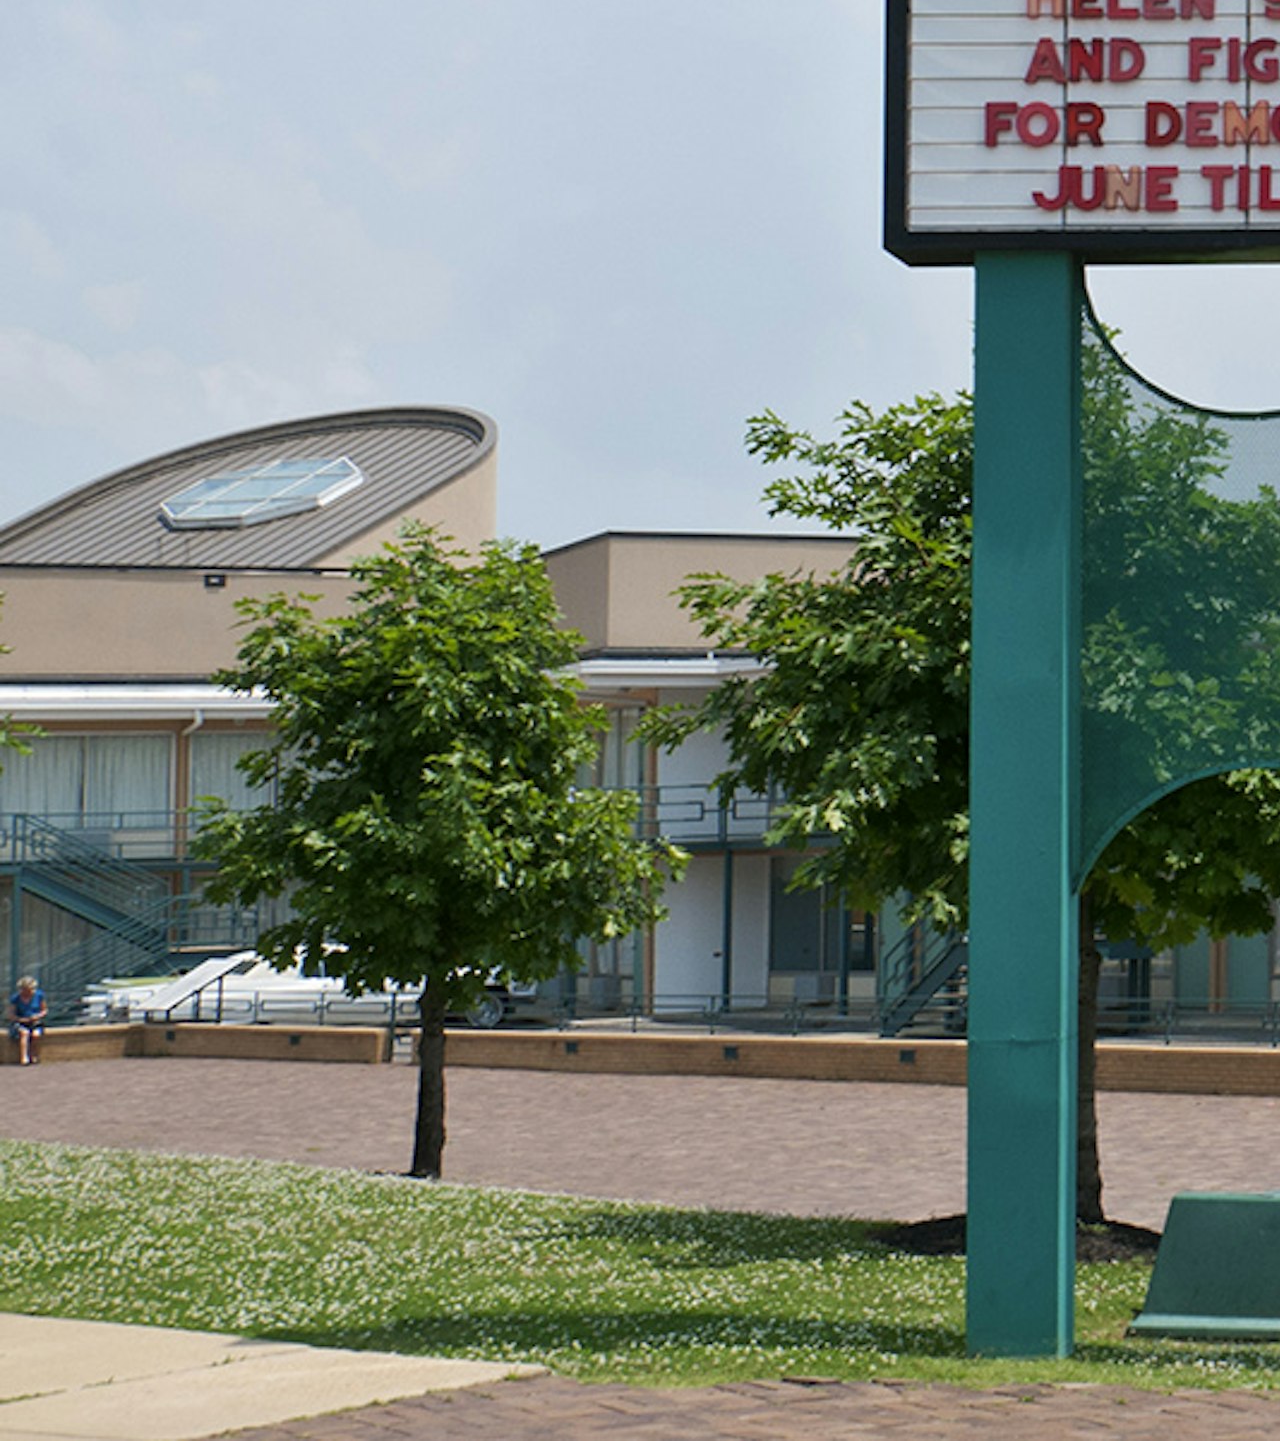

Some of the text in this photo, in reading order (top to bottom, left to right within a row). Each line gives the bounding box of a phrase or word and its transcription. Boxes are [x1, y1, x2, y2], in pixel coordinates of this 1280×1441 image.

[1025, 38, 1144, 83] AND
[986, 102, 1104, 147] FOR
[1033, 165, 1179, 211] JUNE
